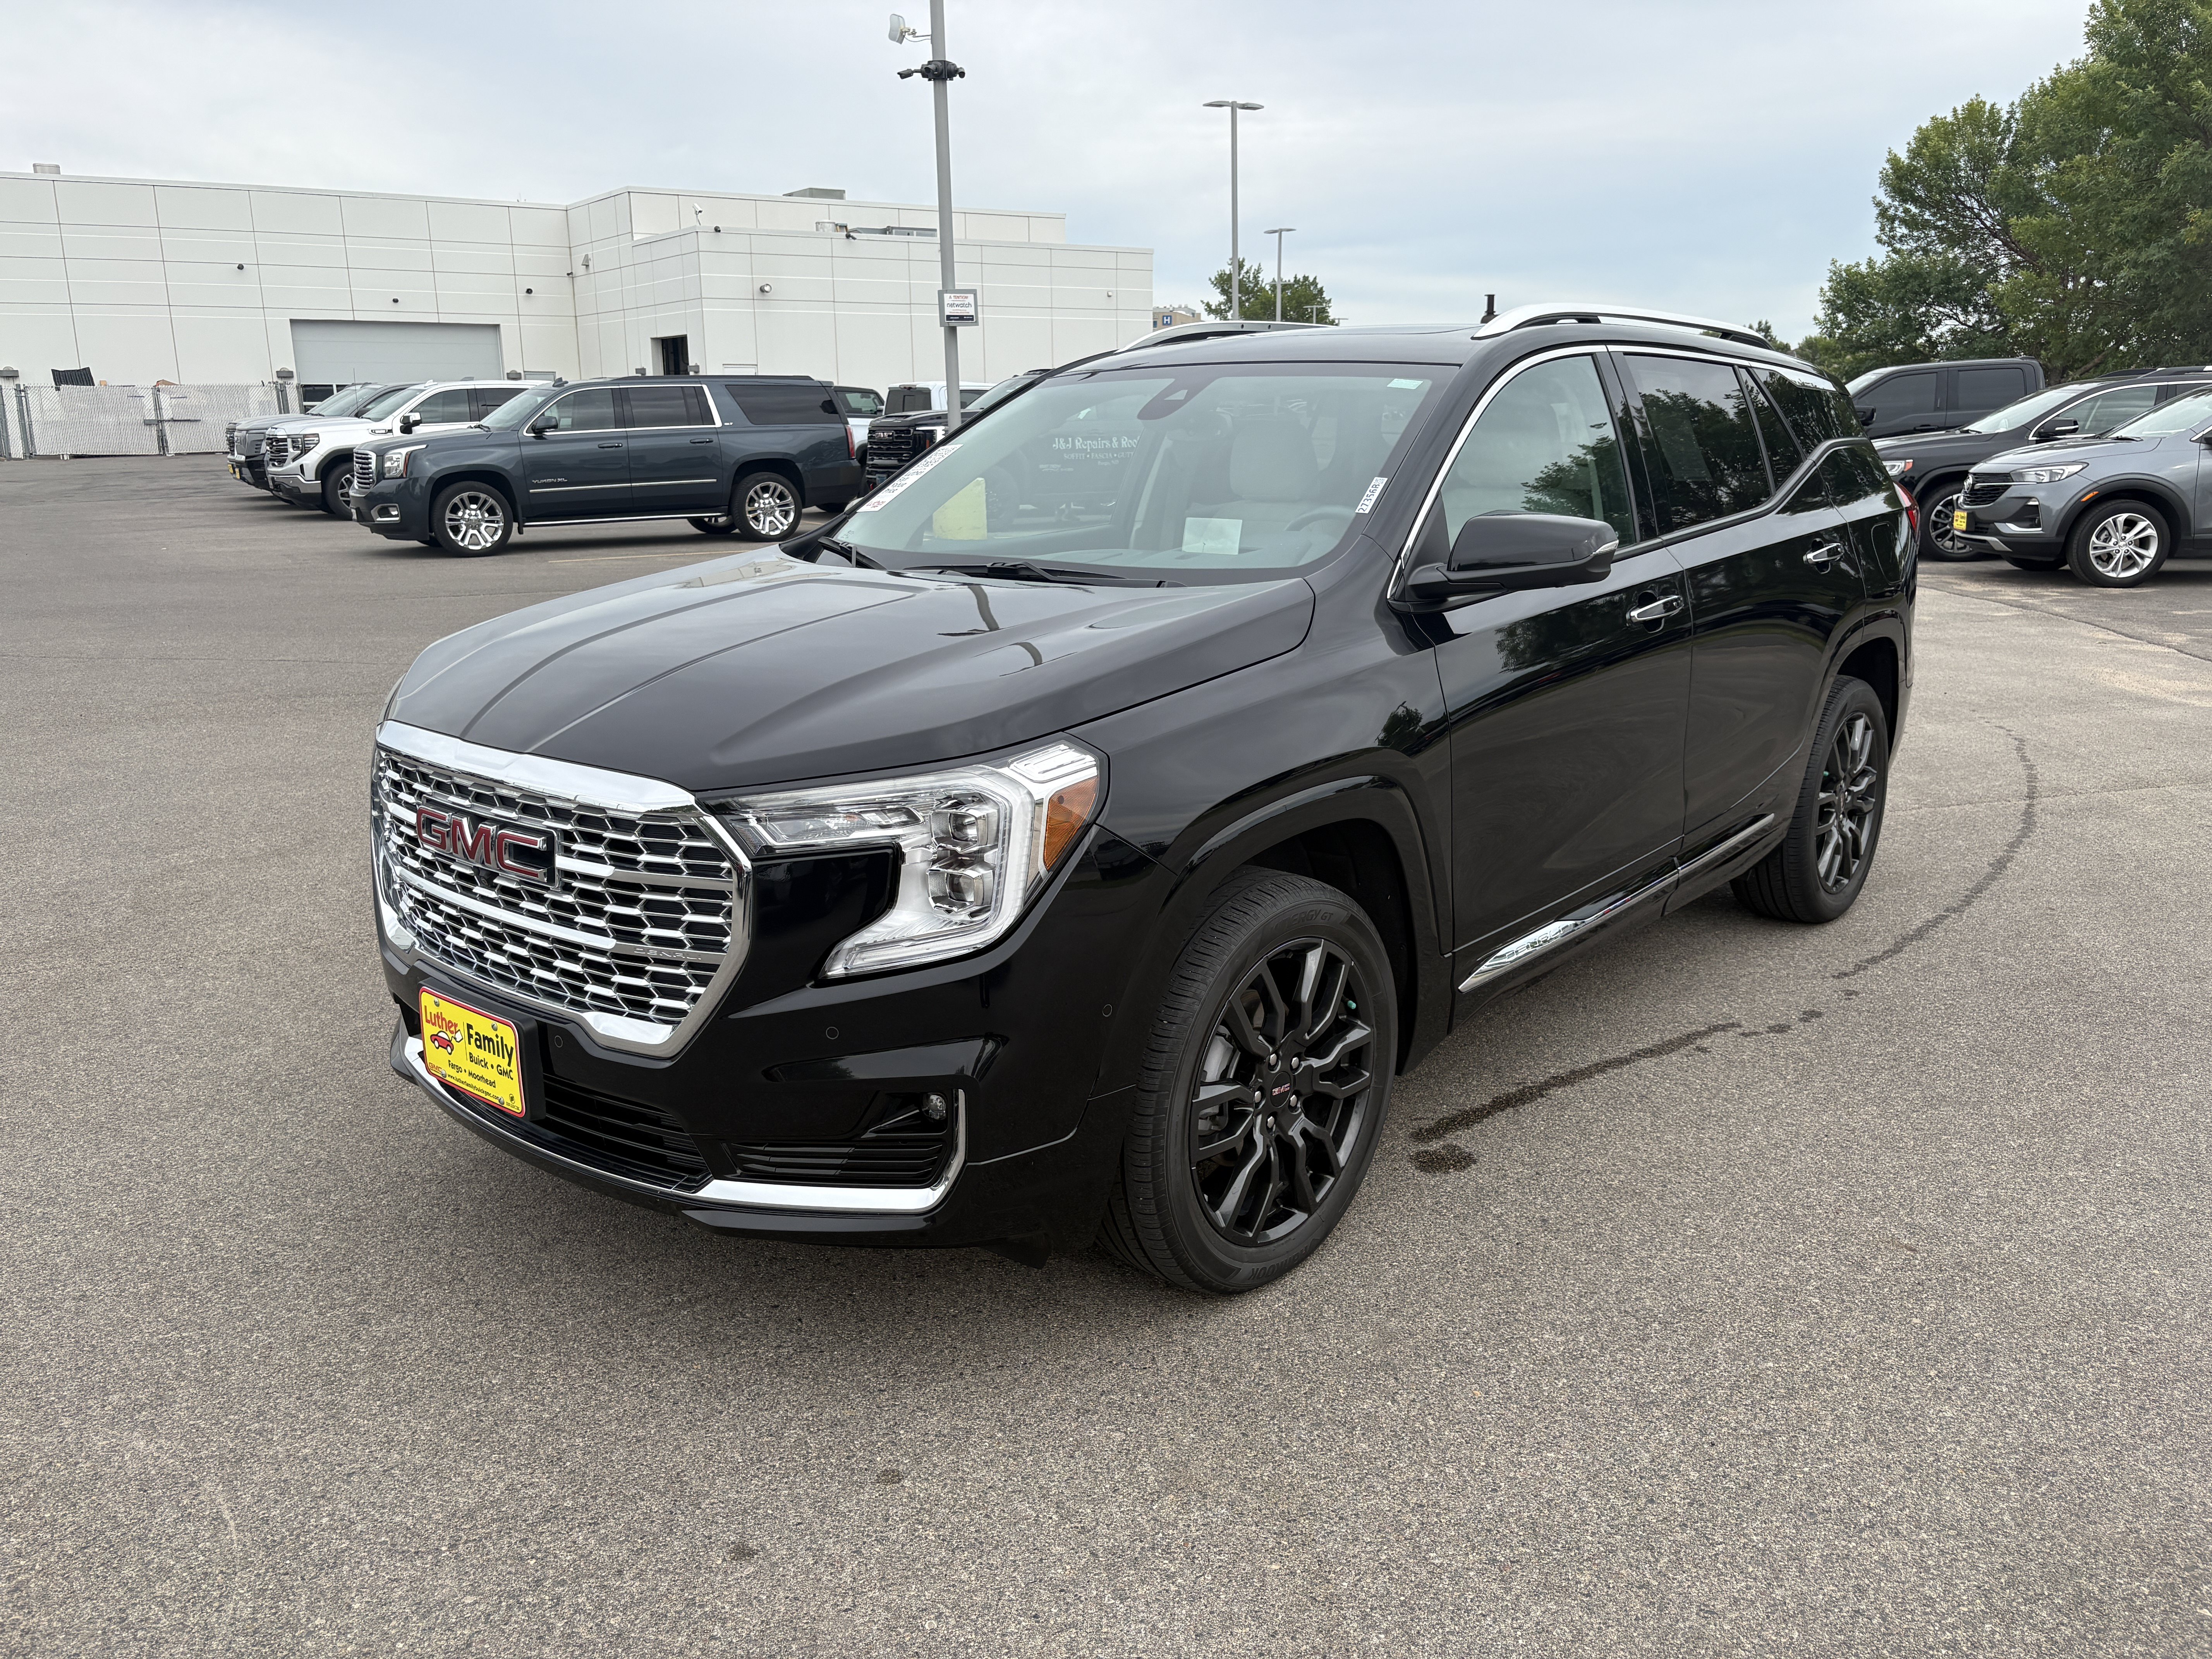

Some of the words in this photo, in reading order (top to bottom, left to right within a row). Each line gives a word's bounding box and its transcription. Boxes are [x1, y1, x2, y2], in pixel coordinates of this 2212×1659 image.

[1075, 437, 1111, 452] Repairs
[1111, 436, 1119, 448] &
[1121, 436, 1140, 448] Roo
[416, 805, 547, 883] GMC
[424, 1005, 458, 1034] Luther
[466, 1022, 514, 1068] Family
[429, 1062, 442, 1072] GMC
[448, 1059, 463, 1073] Fargo
[468, 1069, 496, 1088] Moorhead
[469, 1051, 489, 1070] Buick
[496, 1064, 514, 1081] GMC
[1272, 1083, 1290, 1096] GMC
[506, 1101, 520, 1111] BUICK
